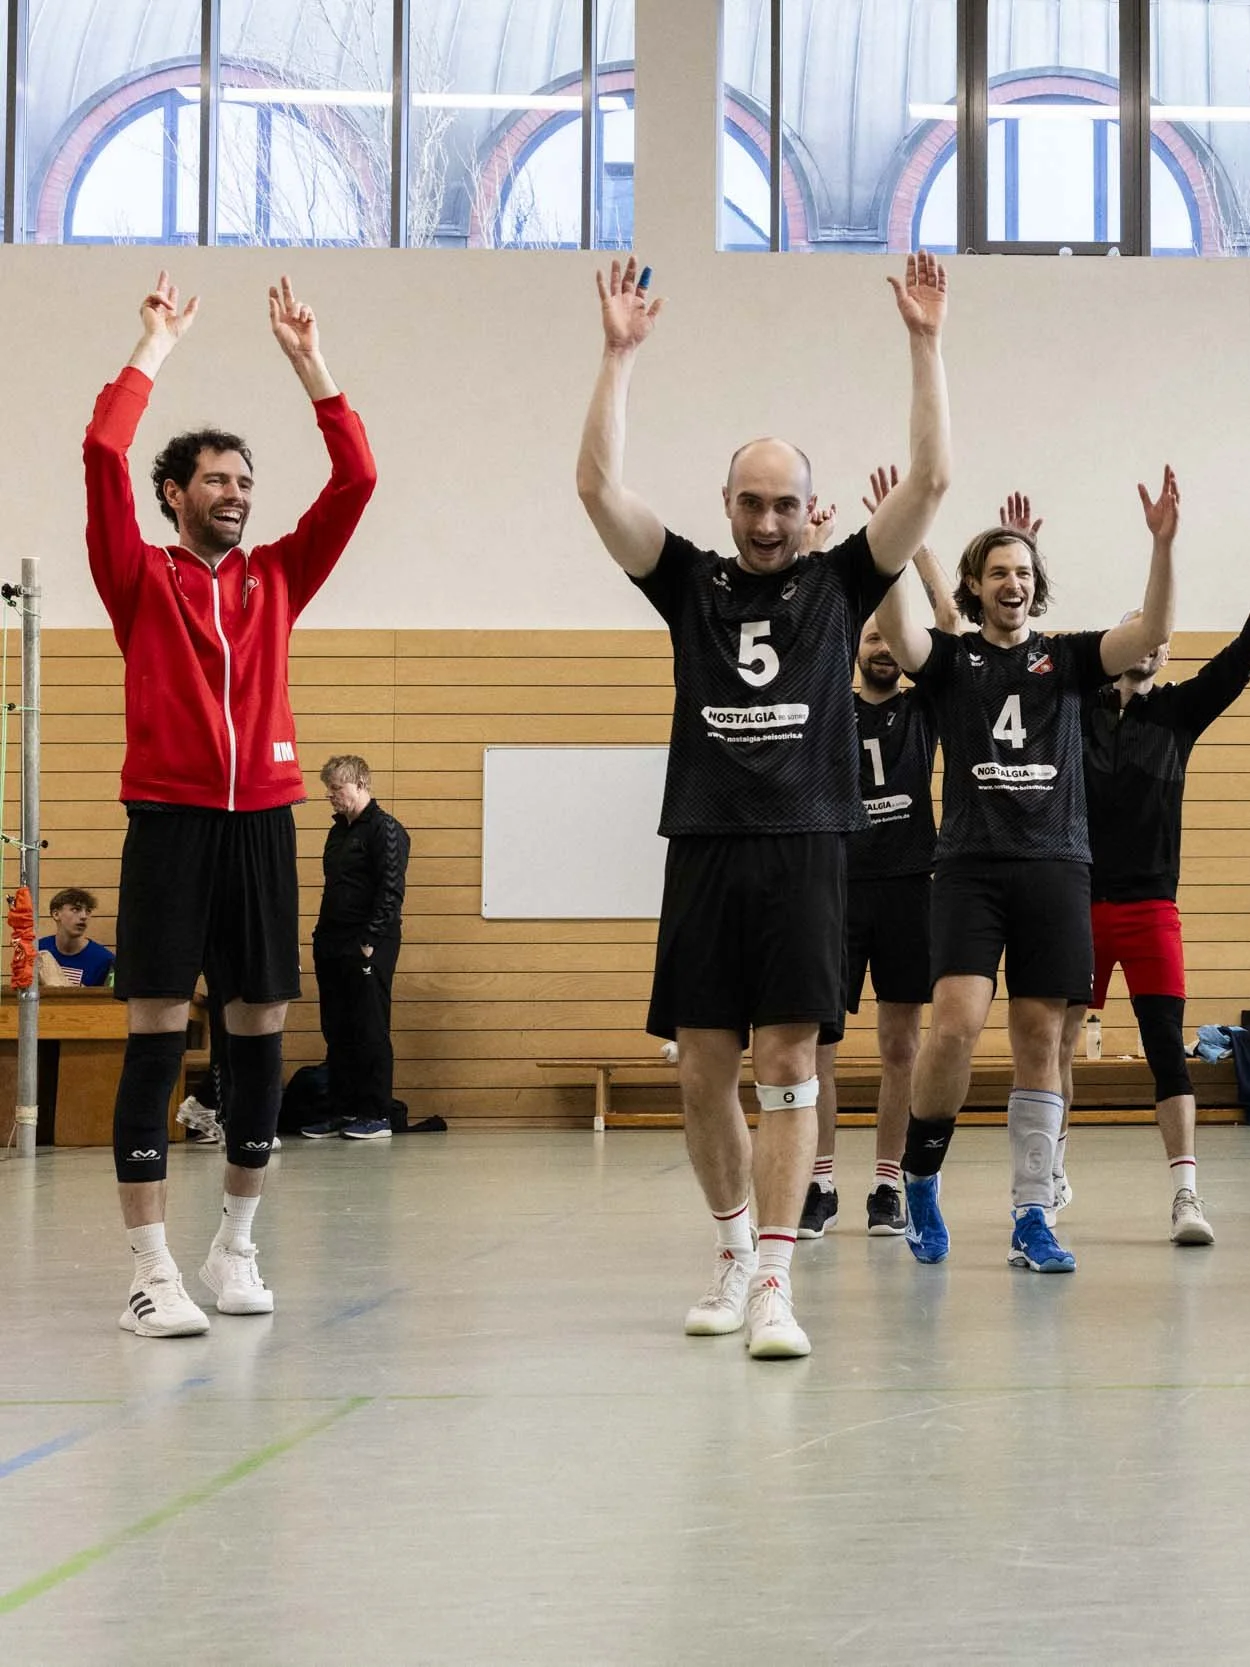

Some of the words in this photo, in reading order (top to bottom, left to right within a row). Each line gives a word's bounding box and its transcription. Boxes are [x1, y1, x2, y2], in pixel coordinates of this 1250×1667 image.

[737, 620, 779, 687] 5
[708, 711, 777, 724] NOSTALGIA
[992, 694, 1027, 749] 4
[863, 738, 885, 786] 1
